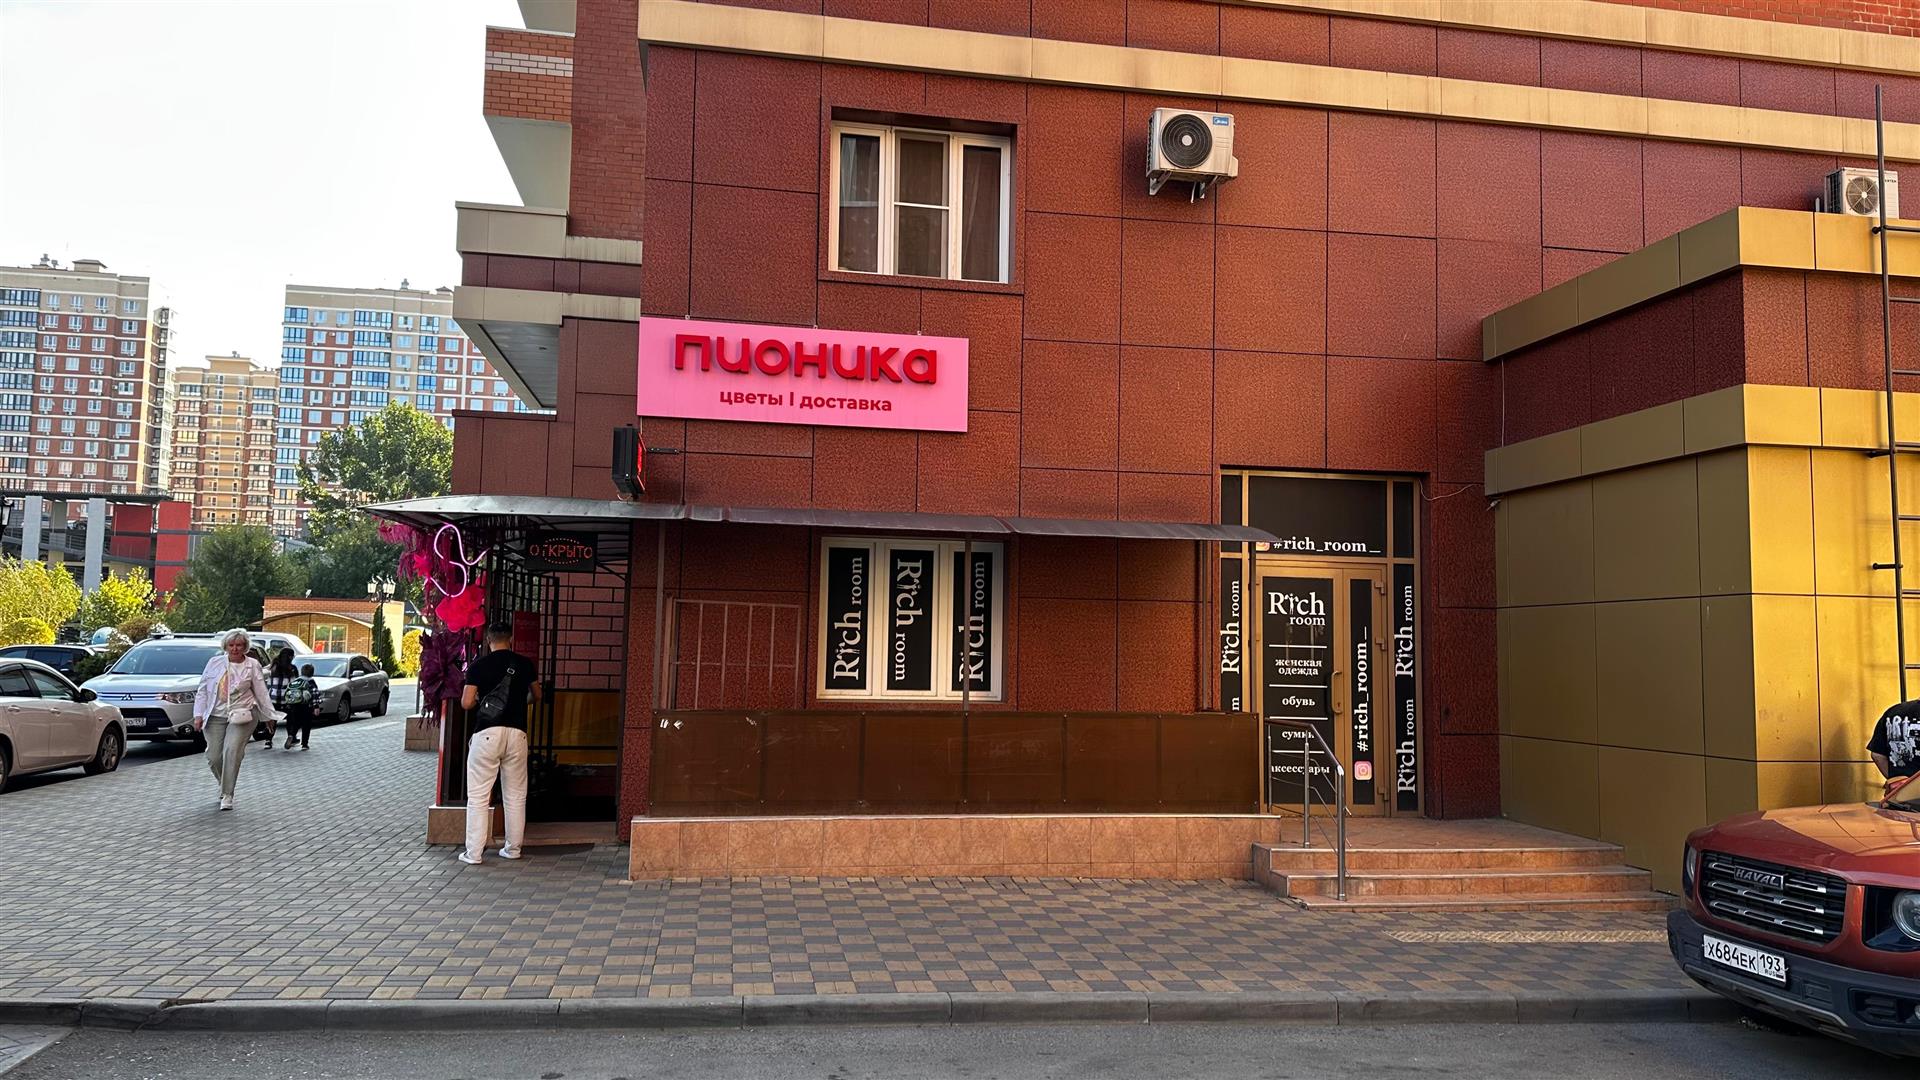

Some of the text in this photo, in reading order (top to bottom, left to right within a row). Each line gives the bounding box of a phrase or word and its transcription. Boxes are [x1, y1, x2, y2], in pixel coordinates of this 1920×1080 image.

[720, 390, 783, 406] цветы
[800, 395, 892, 412] доставка
[529, 544, 593, 559] ОТКРЫТО
[974, 561, 985, 608] room
[1268, 592, 1326, 616] Rich
[834, 557, 862, 680] Rich room
[895, 559, 923, 681] Rich room
[1220, 580, 1240, 674] Rich room
[1289, 616, 1326, 626] room
[1394, 585, 1414, 678] Rich room
[1275, 659, 1322, 667] женская
[1278, 667, 1319, 676] одежда
[1282, 696, 1316, 708] обувь
[1396, 699, 1416, 793] Rich room
[1736, 868, 1779, 886] HAVAL
[1759, 953, 1781, 972] 193
